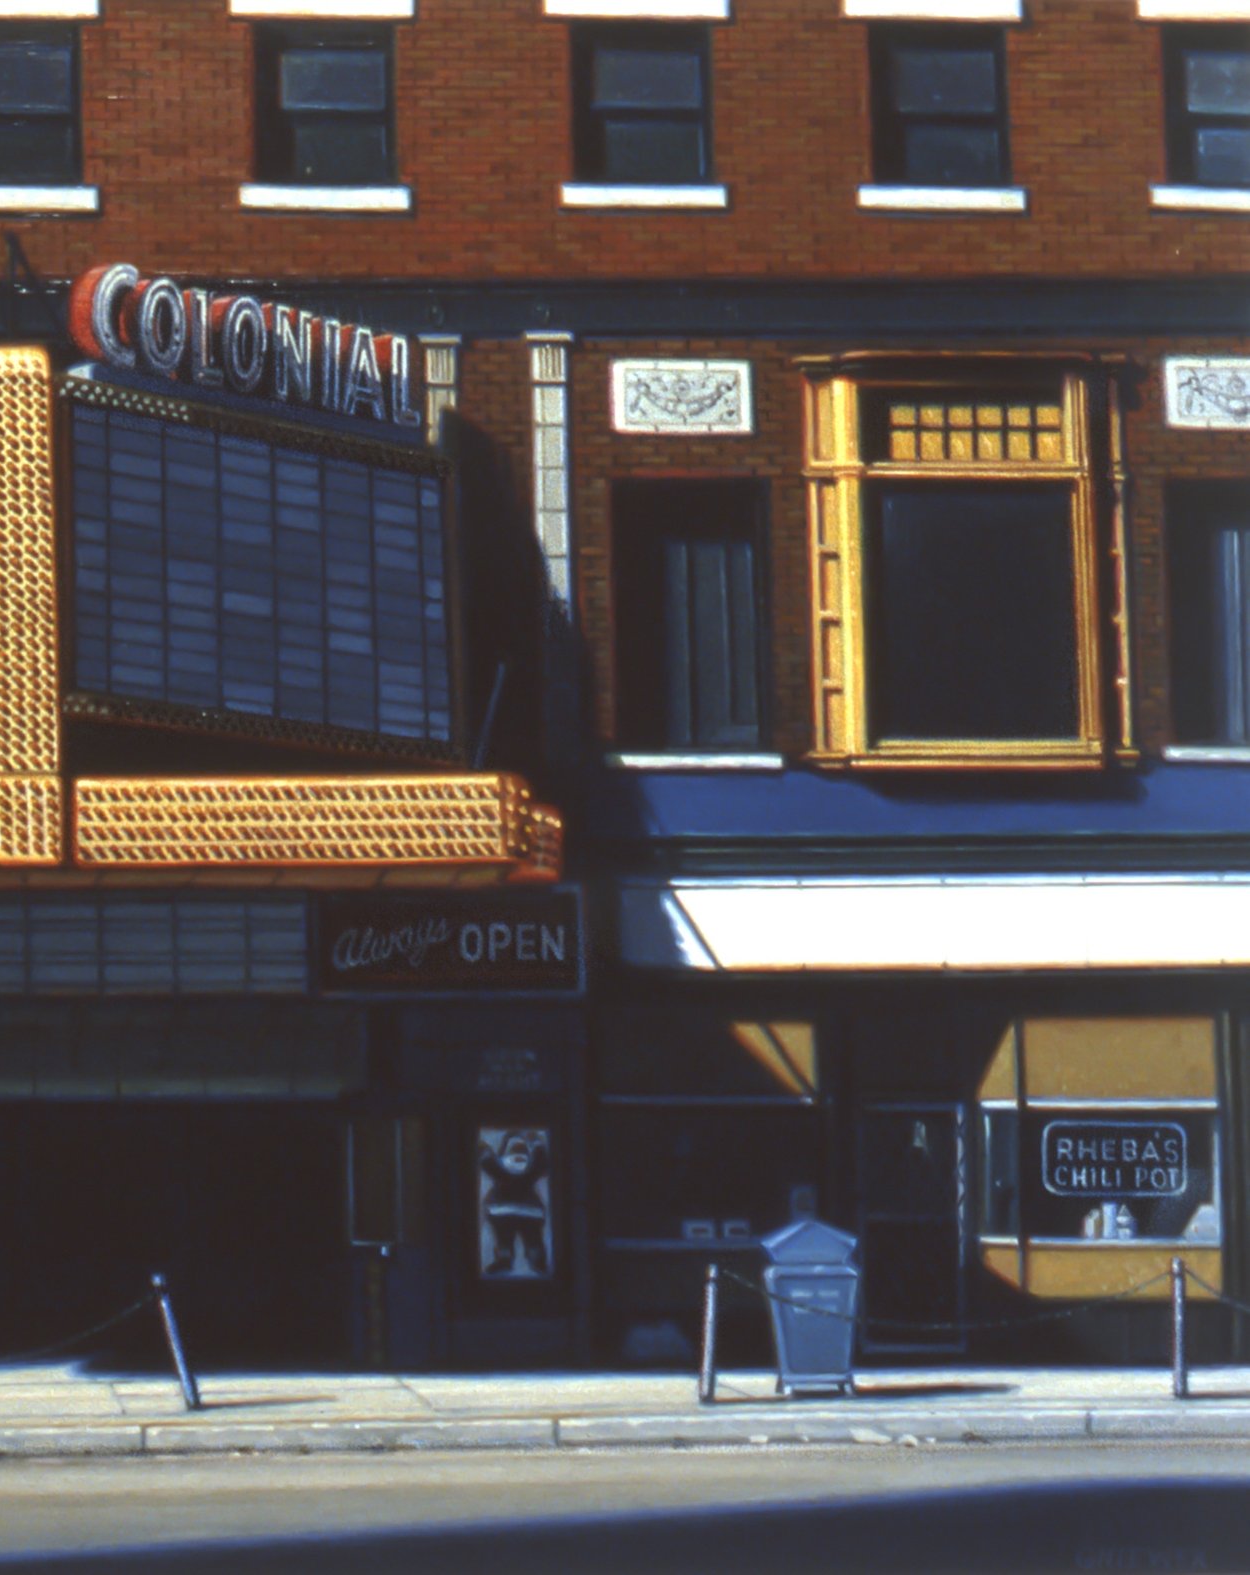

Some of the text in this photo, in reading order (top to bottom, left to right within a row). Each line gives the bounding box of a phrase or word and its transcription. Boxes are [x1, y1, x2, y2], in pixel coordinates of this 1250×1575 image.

[88, 262, 421, 427] COLONIAL
[332, 918, 565, 970] Always OPEN
[1056, 1131, 1180, 1164] RHEBA'S
[1054, 1166, 1180, 1189] CHILI POT
